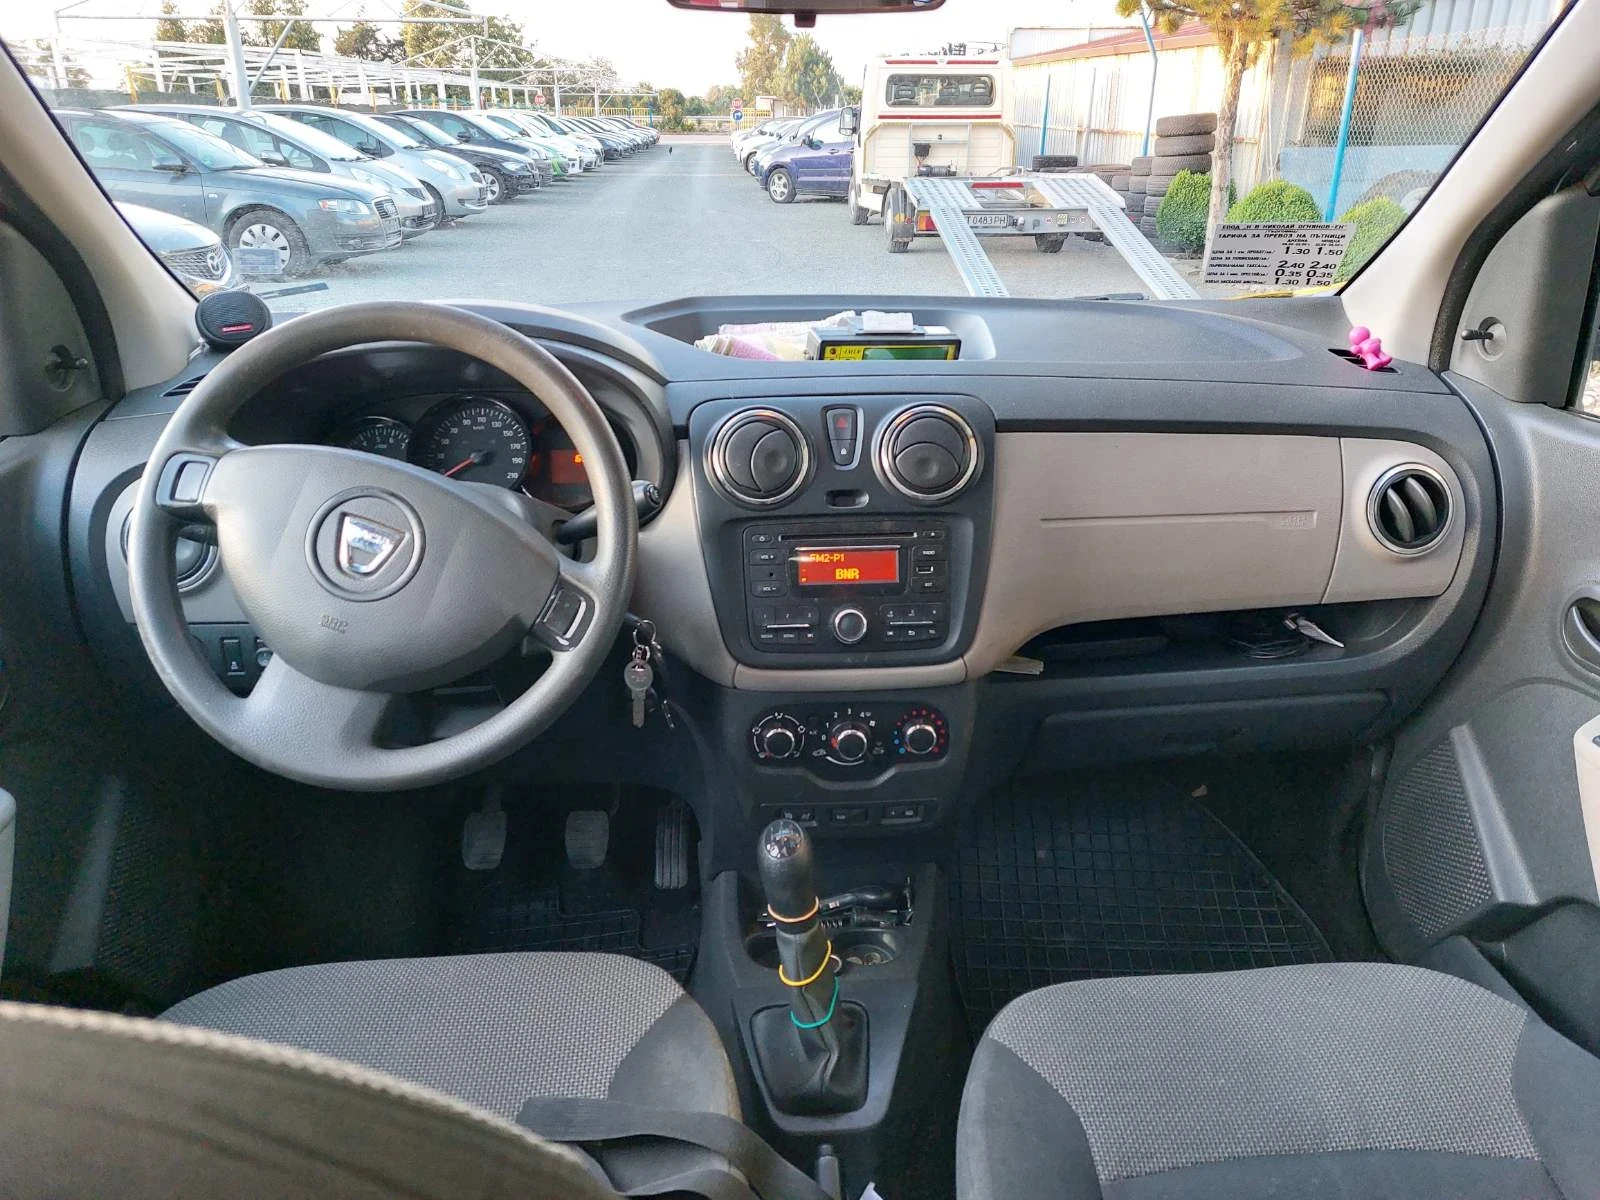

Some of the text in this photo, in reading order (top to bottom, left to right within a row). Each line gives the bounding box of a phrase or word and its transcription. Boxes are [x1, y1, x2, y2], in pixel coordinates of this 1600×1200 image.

[972, 215, 992, 224] 0483
[1284, 247, 1310, 255] 1.30
[1317, 247, 1343, 255] 1.50
[1278, 261, 1304, 269] 2.40
[835, 568, 860, 580] BNR
